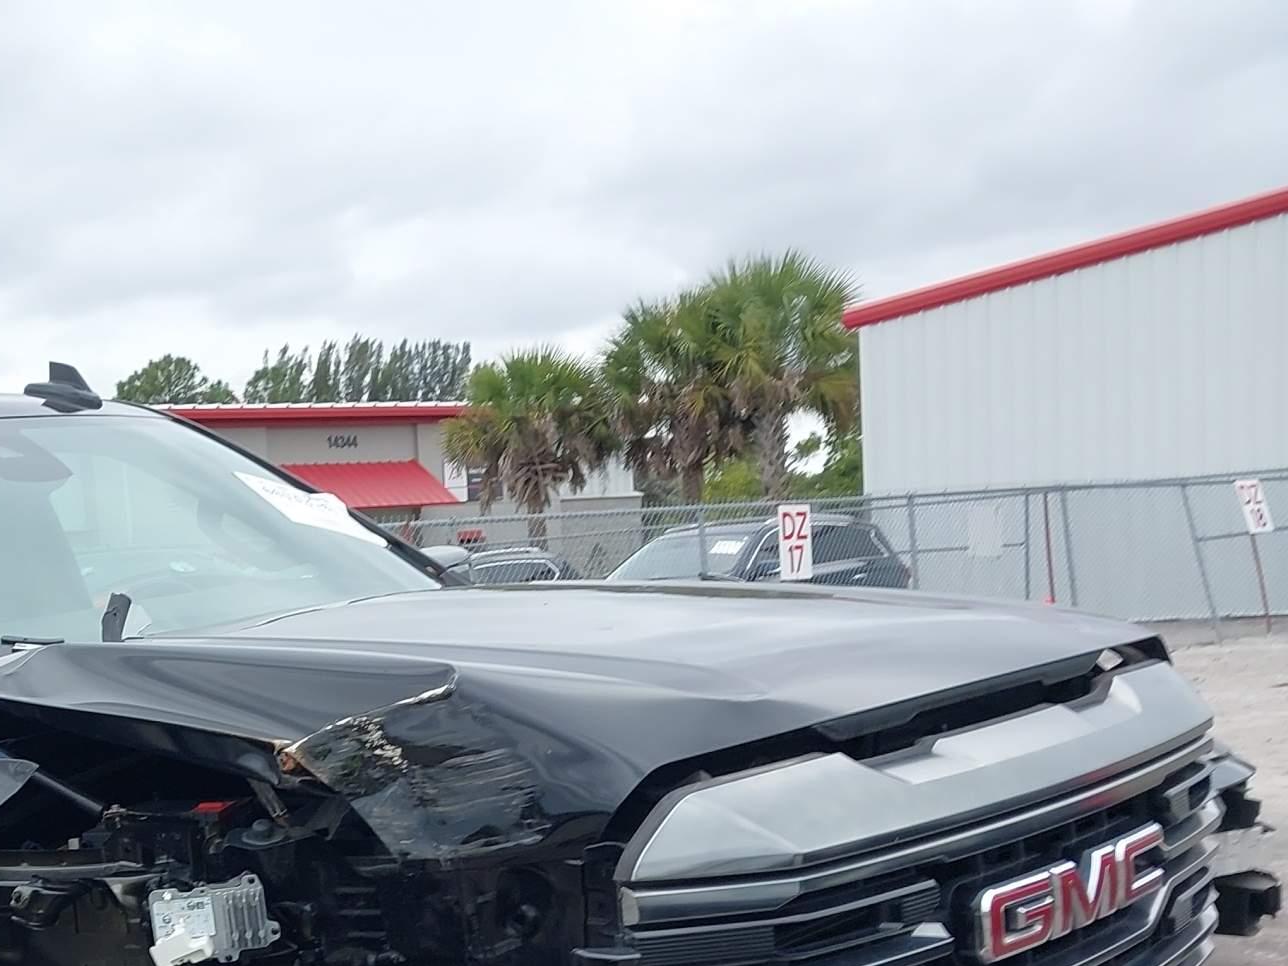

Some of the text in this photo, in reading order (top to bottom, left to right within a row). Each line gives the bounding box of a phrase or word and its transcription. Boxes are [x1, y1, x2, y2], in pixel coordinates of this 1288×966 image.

[327, 435, 358, 449] 14344
[781, 511, 809, 541] DZ
[788, 545, 804, 574] 17
[980, 822, 1164, 964] GMC
